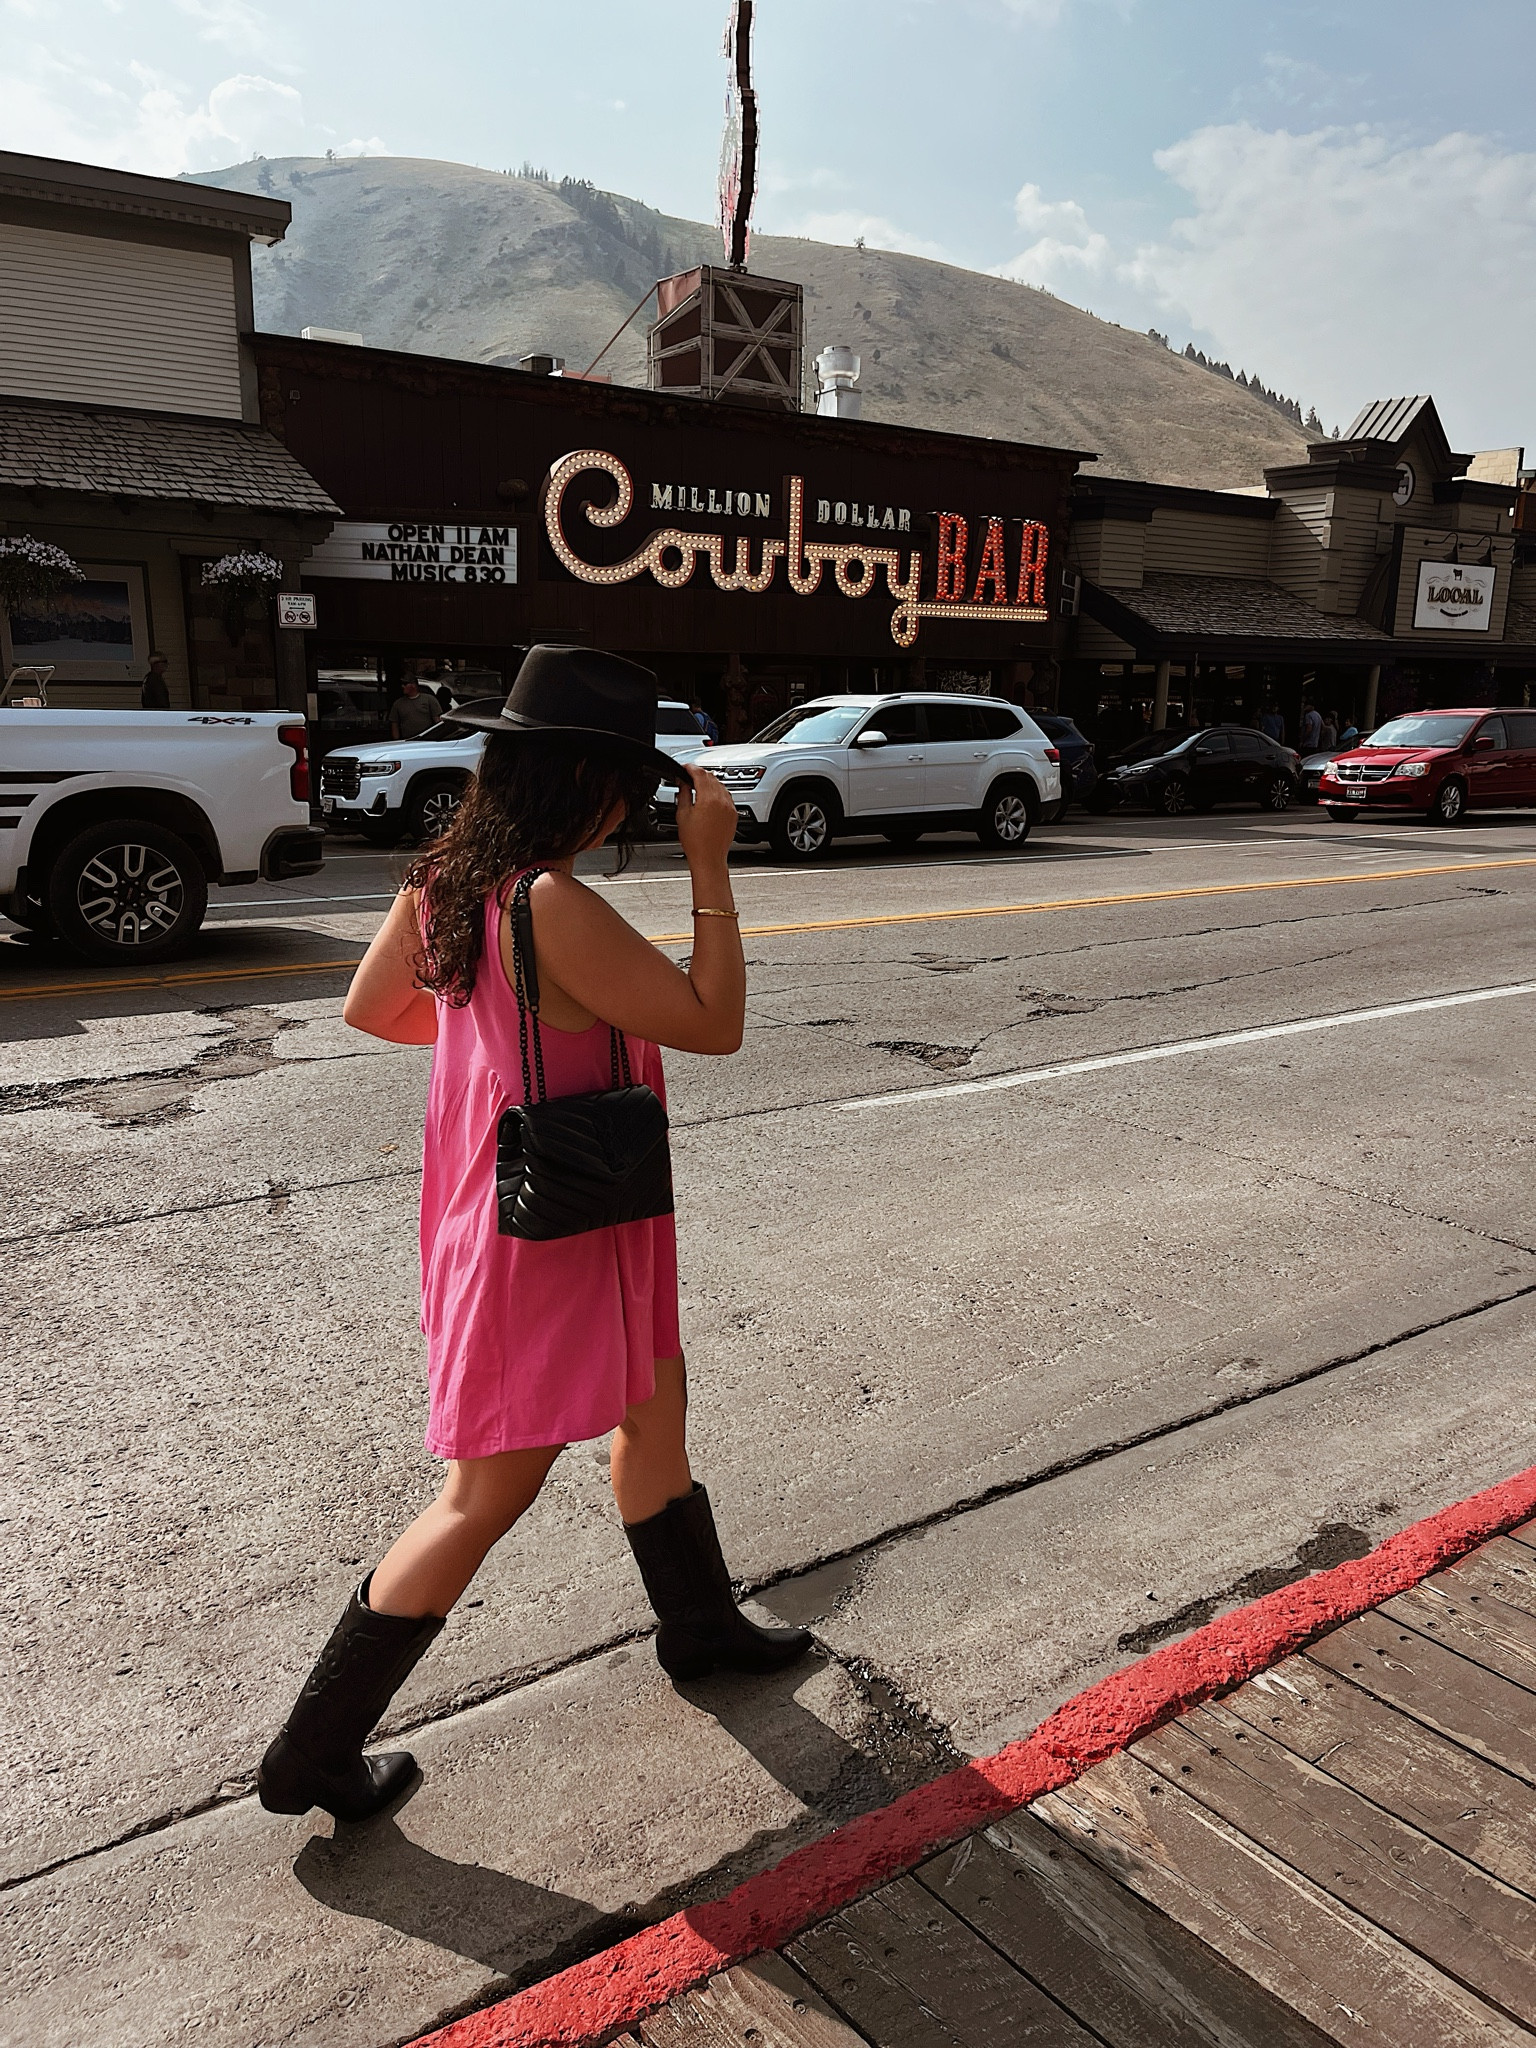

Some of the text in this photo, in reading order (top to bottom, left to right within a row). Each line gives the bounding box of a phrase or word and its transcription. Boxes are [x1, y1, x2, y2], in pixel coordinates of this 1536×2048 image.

[650, 482, 912, 533] MILLION DOLLAR
[387, 523, 445, 544] OPEN
[361, 542, 505, 565] NATHAN DEAN
[542, 449, 1050, 649] Cowboy BAR
[391, 562, 506, 583] MUSIC 830
[1427, 585, 1484, 605] LOCAL
